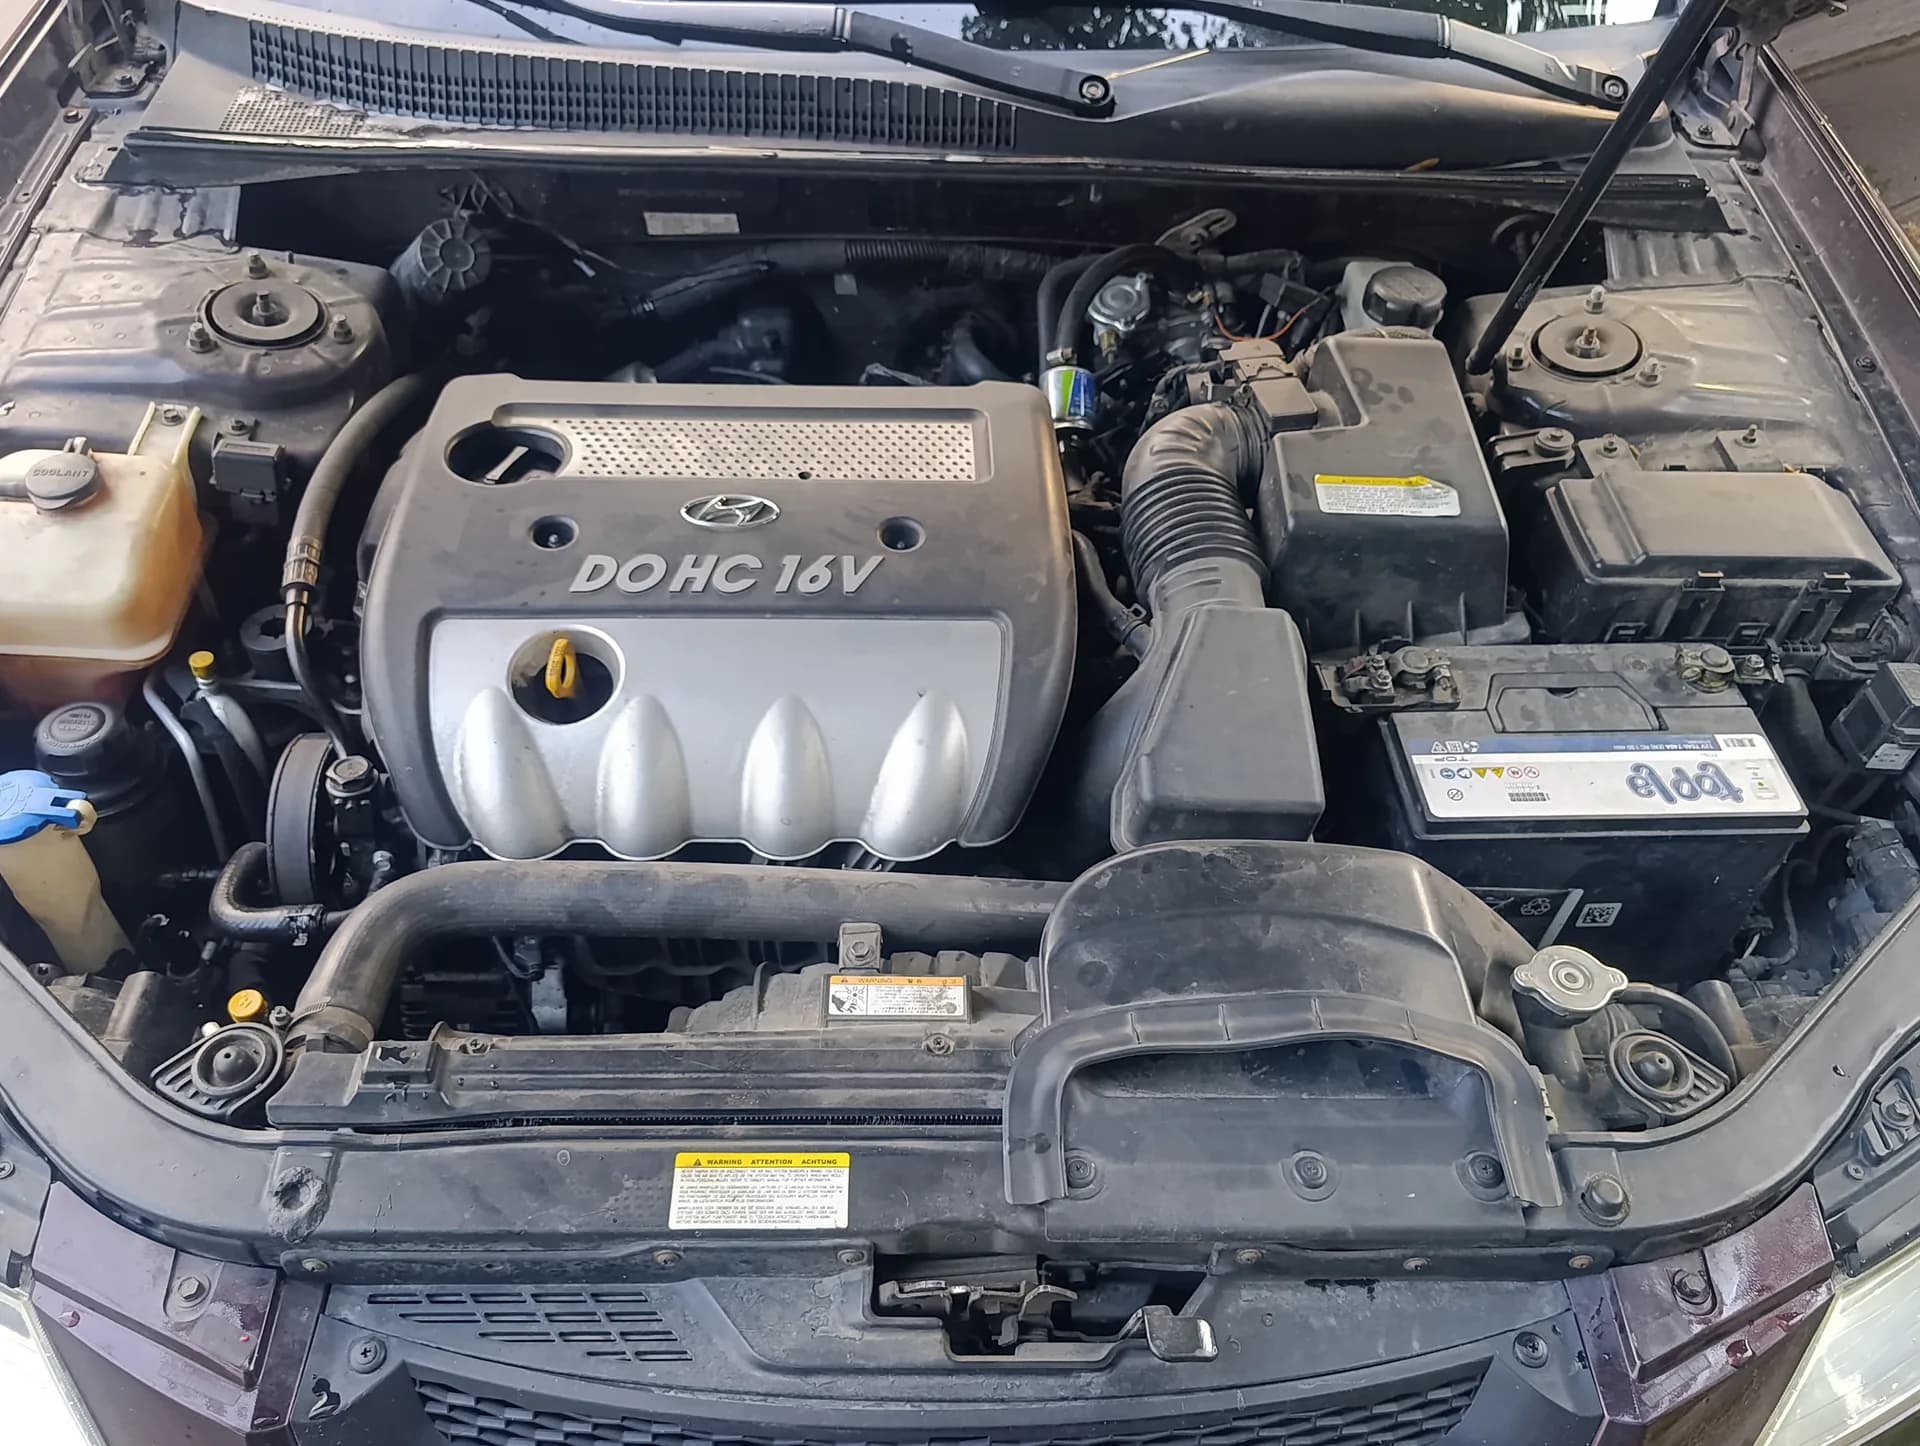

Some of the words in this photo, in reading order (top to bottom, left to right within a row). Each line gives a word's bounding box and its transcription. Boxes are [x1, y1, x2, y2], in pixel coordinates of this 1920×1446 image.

[32, 468, 89, 477] COOLANT
[568, 553, 763, 594] DOHC
[774, 554, 886, 595] 16V
